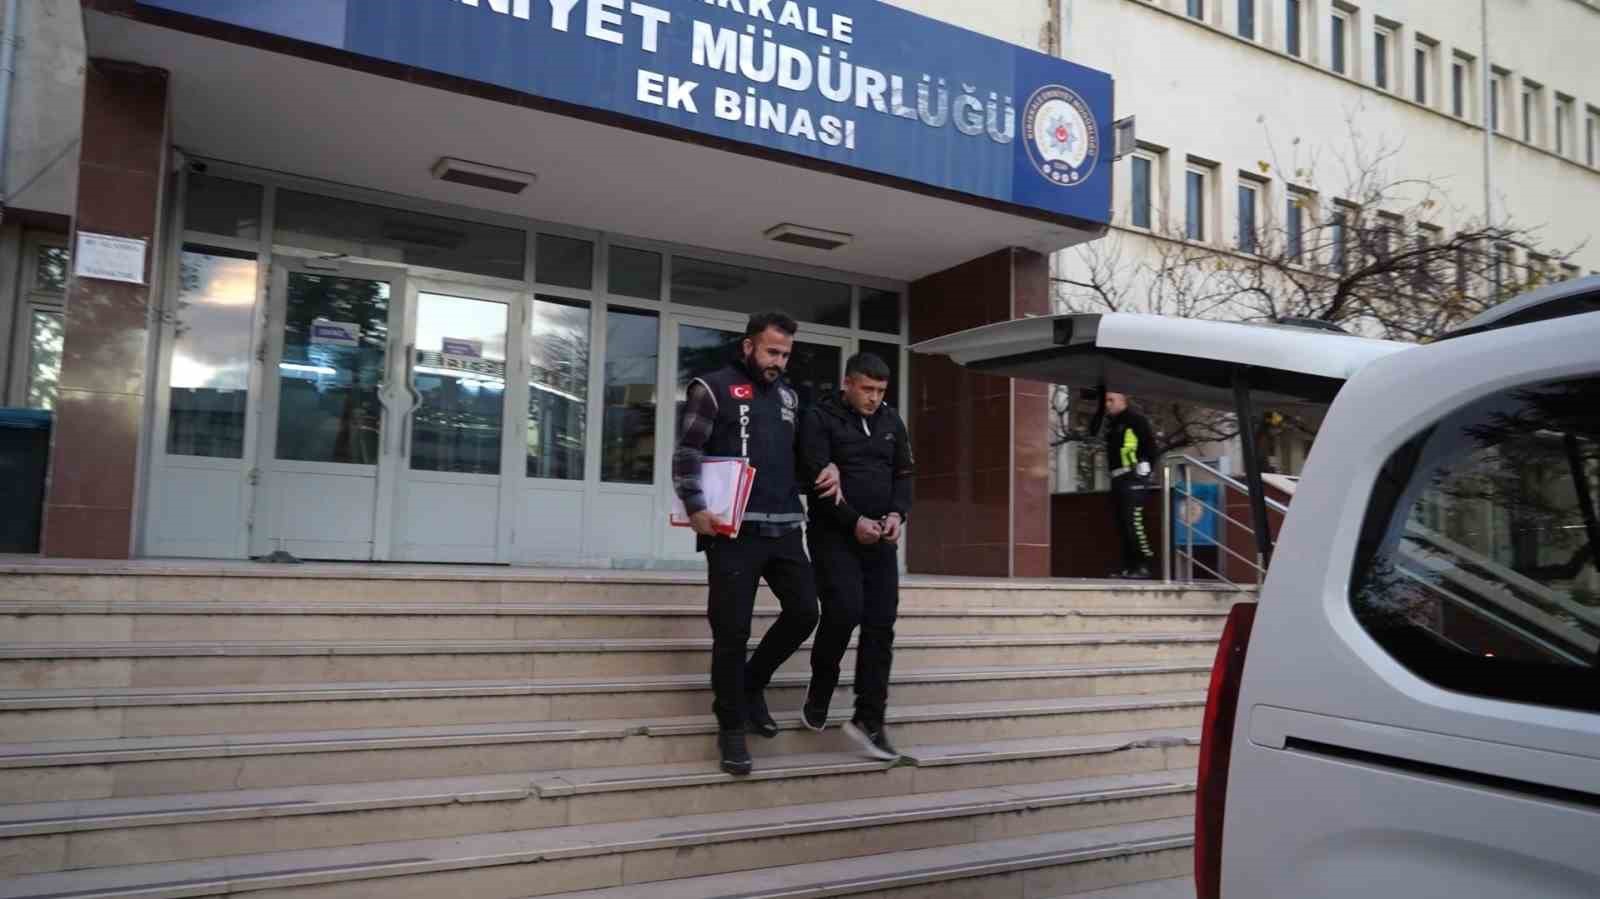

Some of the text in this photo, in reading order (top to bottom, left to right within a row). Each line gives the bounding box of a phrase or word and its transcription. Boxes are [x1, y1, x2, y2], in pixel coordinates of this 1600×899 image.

[704, 0, 853, 44] KALE
[461, 0, 671, 52] YET
[692, 20, 1015, 144] MÜDÜRLÜĞÜ
[636, 69, 855, 149] EK BİNASI
[740, 405, 750, 464] POLİ
